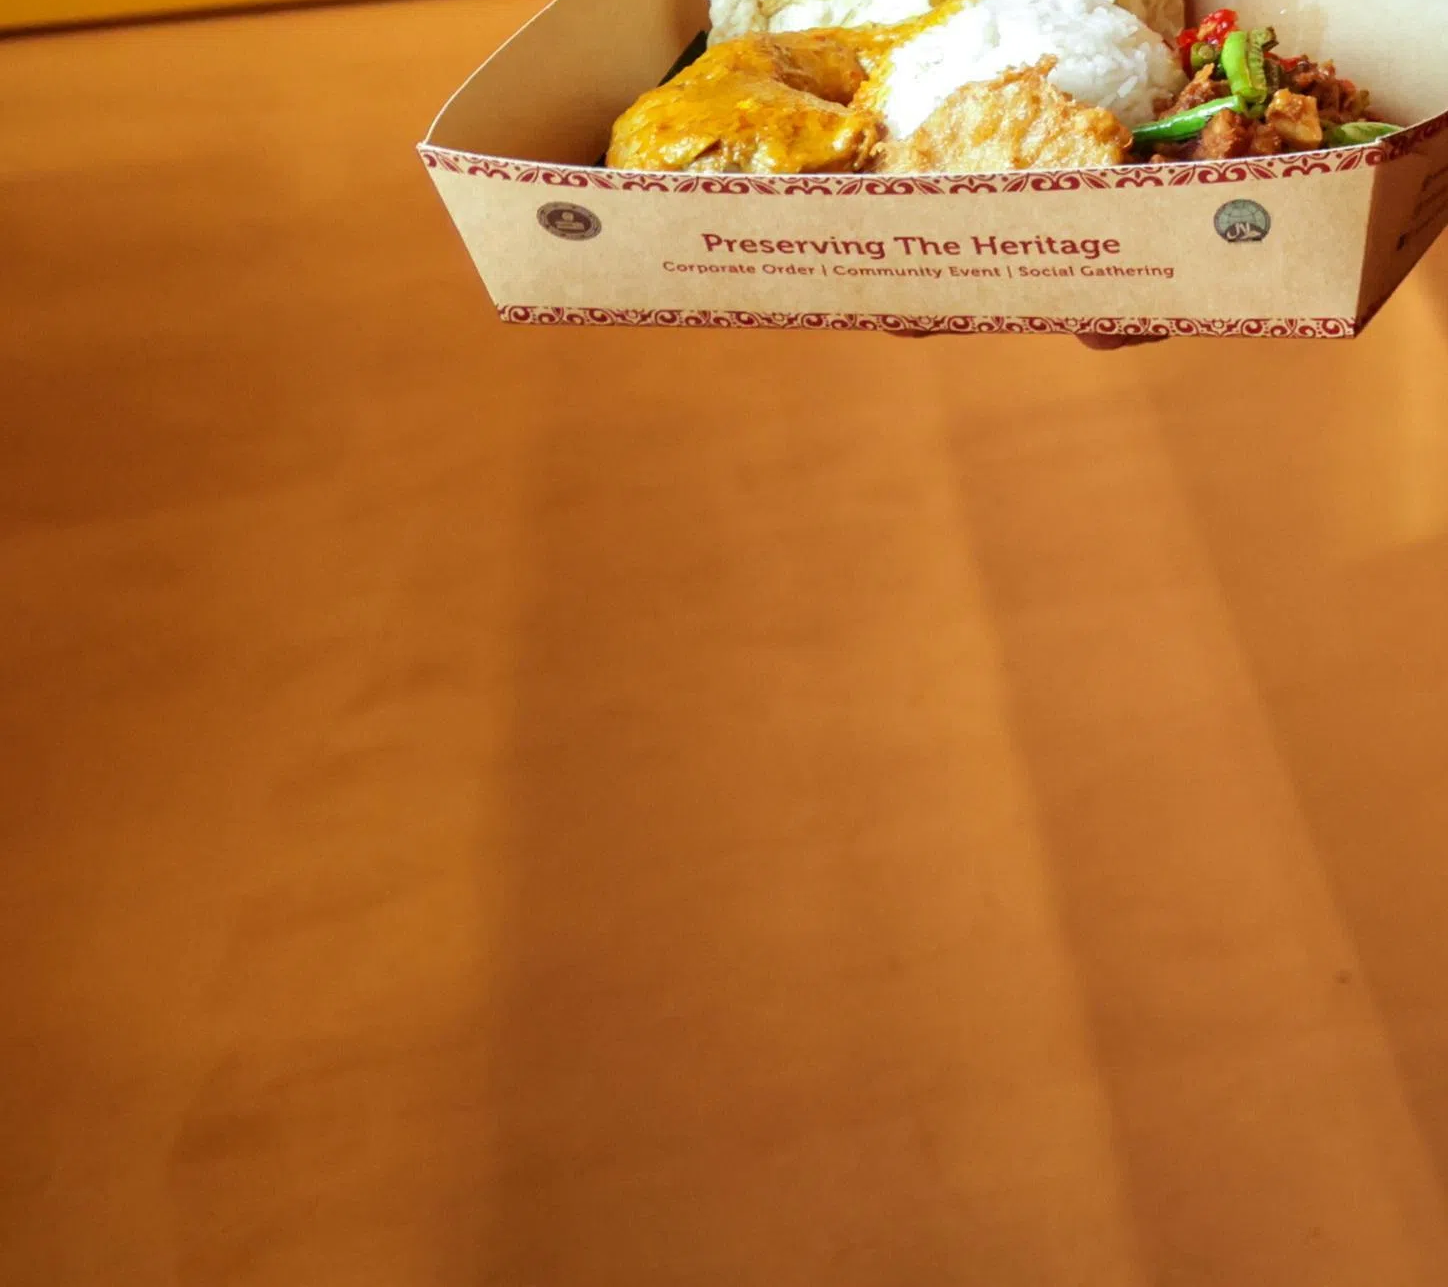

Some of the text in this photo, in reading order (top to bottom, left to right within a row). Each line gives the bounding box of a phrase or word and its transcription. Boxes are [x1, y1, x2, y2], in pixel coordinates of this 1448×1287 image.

[701, 232, 1121, 260] Preserving The Heritage
[662, 261, 1175, 279] Corporate Order Community Event Social Gathering
